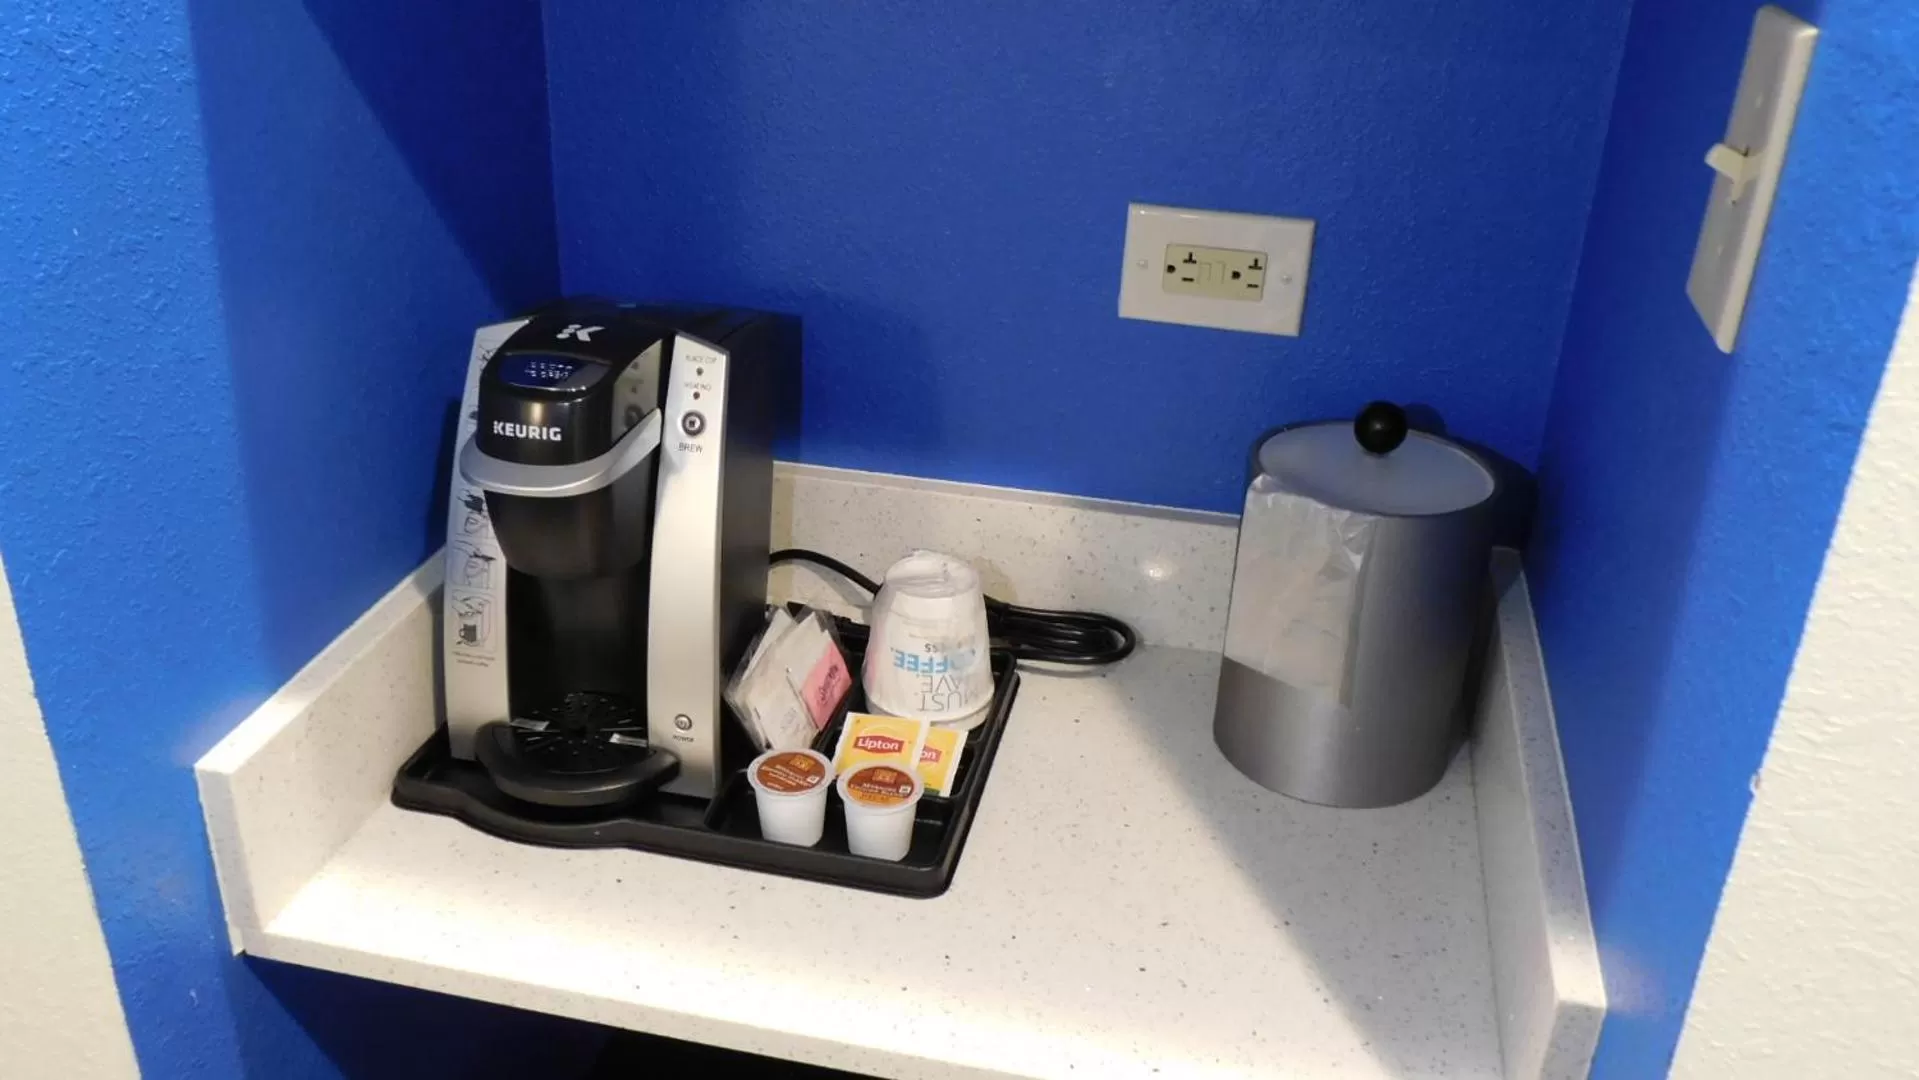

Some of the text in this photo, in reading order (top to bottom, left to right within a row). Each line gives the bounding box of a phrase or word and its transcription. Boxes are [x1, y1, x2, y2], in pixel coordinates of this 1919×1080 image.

[492, 420, 563, 441] KEURIG
[678, 442, 704, 454] BREW
[856, 737, 900, 751] Lipton
